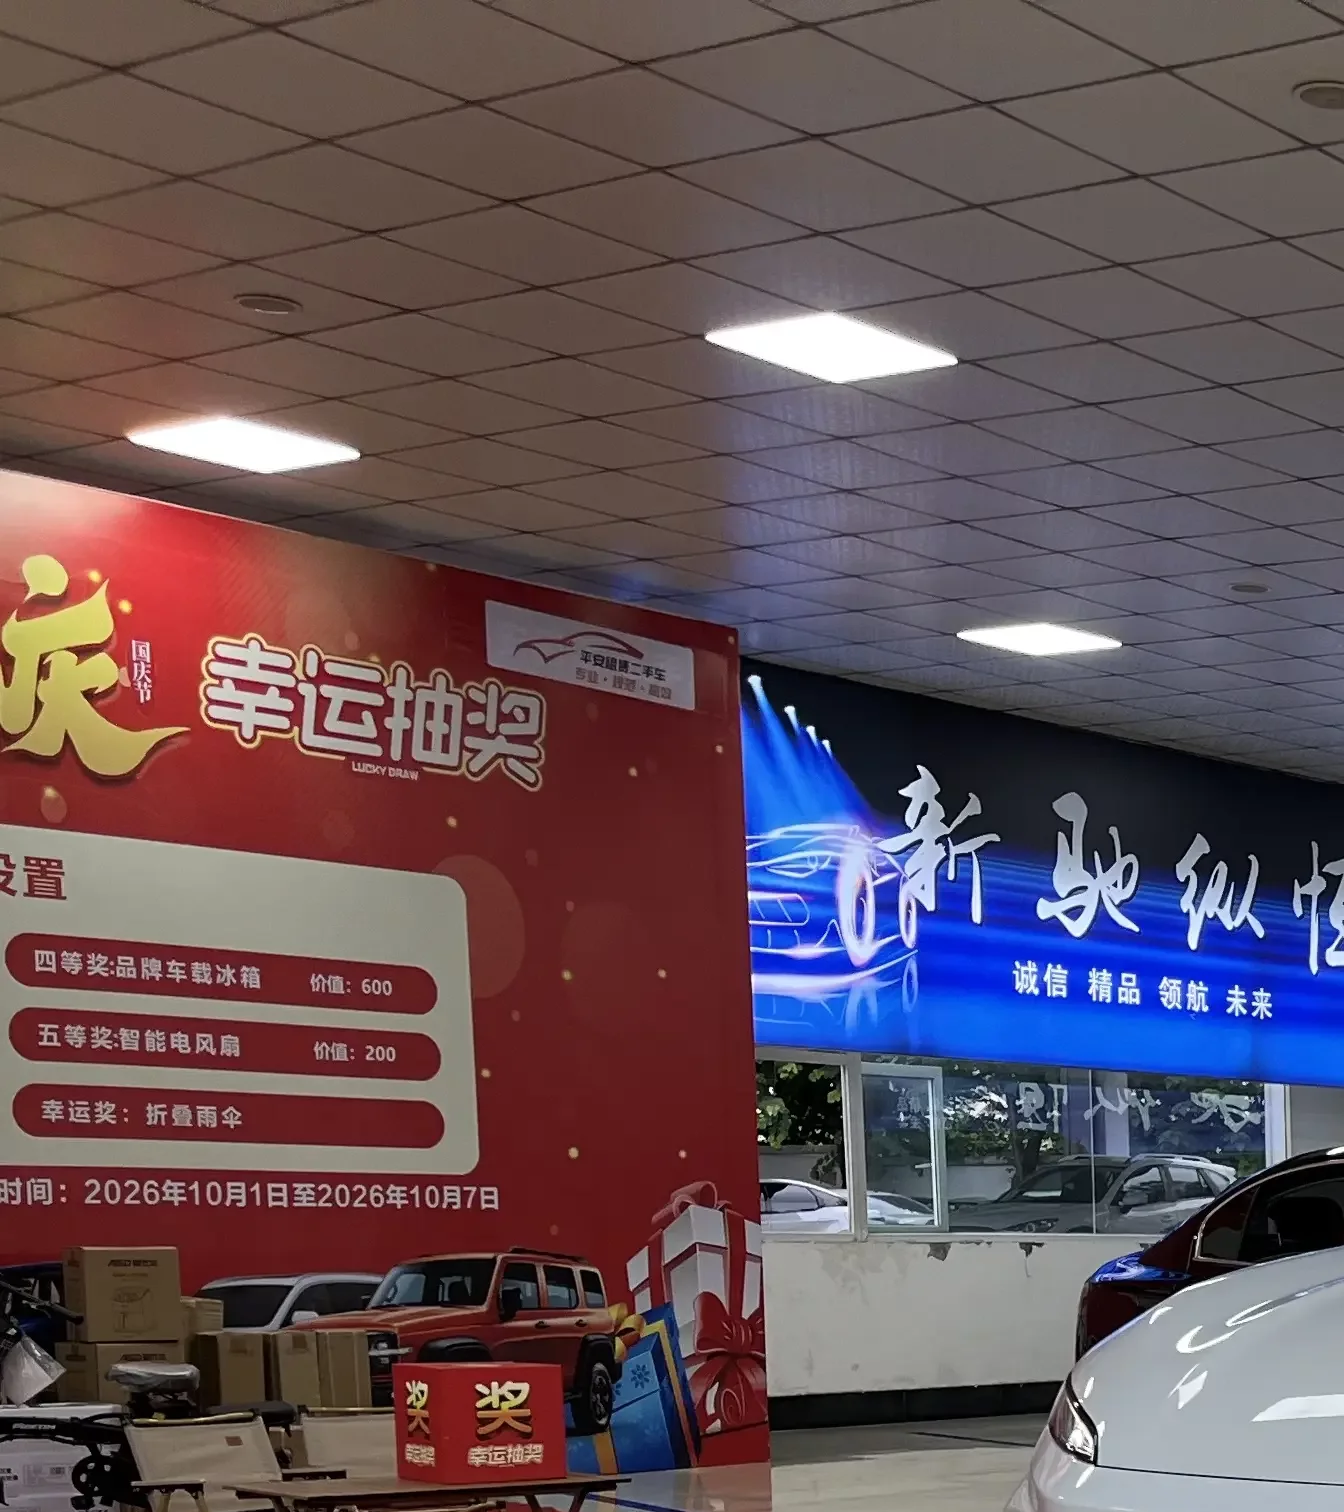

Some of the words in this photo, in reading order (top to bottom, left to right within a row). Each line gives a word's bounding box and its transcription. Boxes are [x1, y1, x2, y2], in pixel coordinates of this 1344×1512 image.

[0, 554, 191, 776] 庆
[131, 639, 152, 703] 国庆节
[203, 636, 543, 788] 幸运抽奖
[351, 761, 387, 776] LUCKY
[388, 767, 419, 781] DRAW
[1012, 960, 1068, 998] 诚信
[1088, 967, 1140, 1005] 精品
[1158, 976, 1209, 1012] 领航
[1226, 984, 1273, 1019] 未来
[405, 1379, 430, 1435] 奖
[475, 1380, 533, 1436] 奖
[468, 1444, 544, 1467] 幸运抽奖
